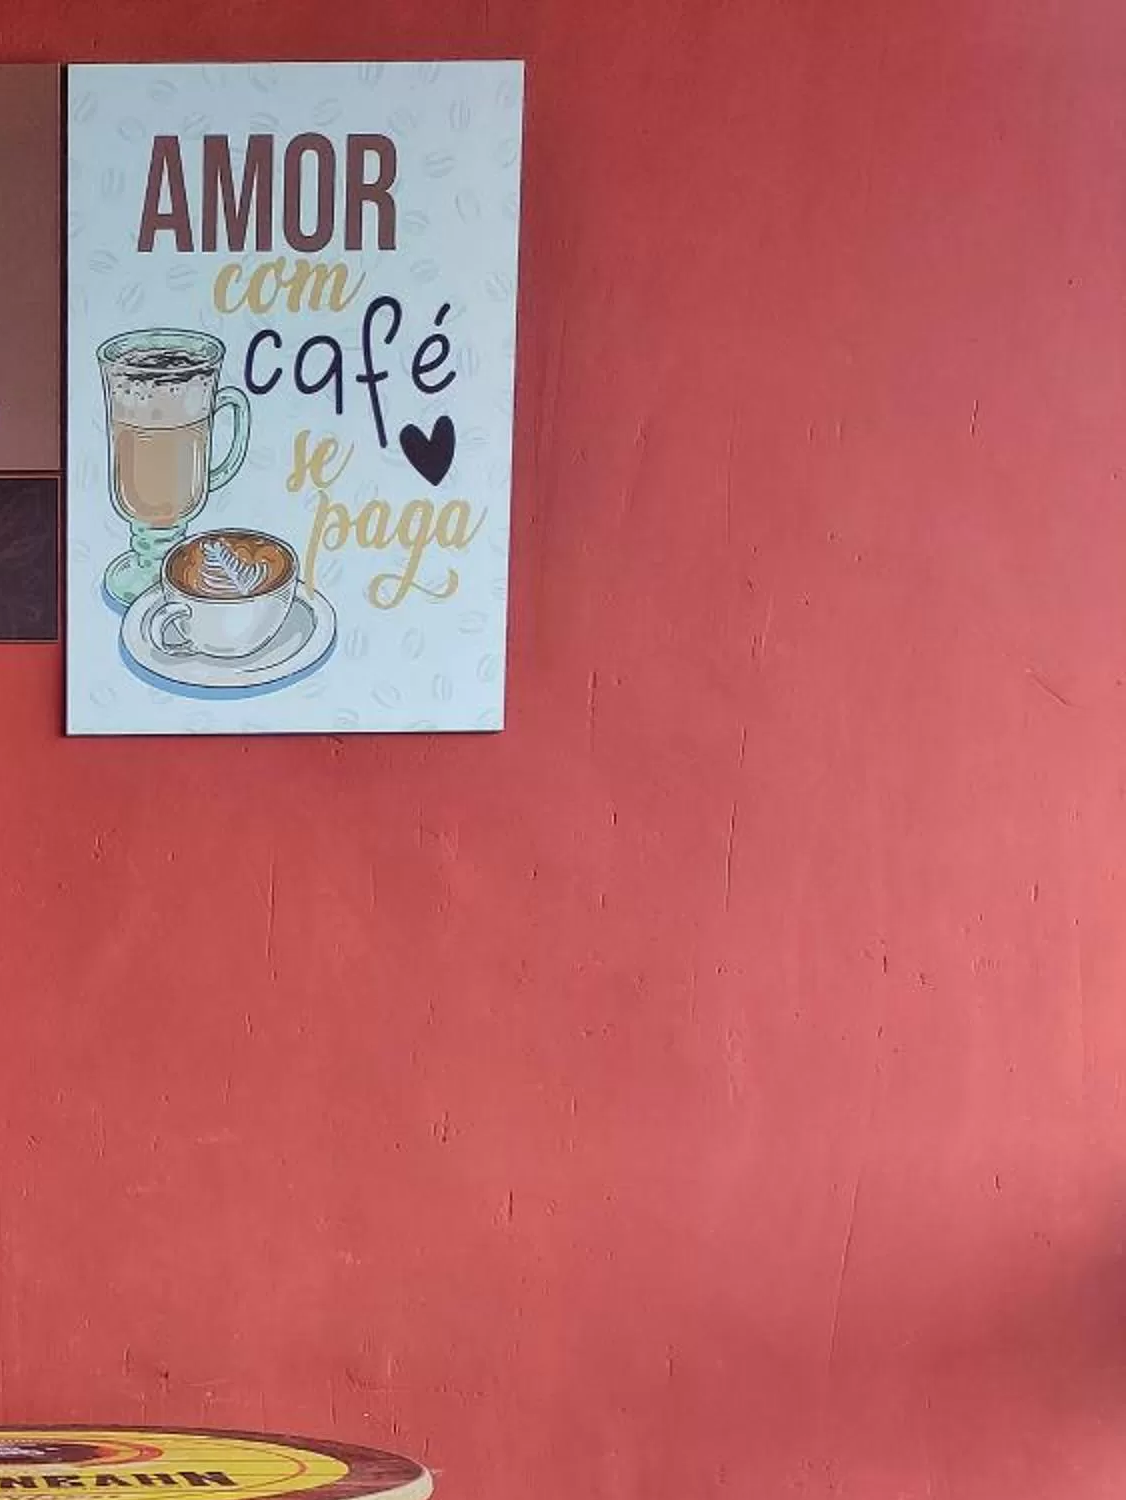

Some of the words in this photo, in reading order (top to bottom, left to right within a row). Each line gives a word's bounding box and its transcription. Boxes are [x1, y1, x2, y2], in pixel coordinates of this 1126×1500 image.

[136, 131, 399, 253] AMOR
[212, 254, 368, 315] com
[243, 294, 458, 449] café
[285, 427, 356, 494] se
[303, 489, 490, 610] paga
